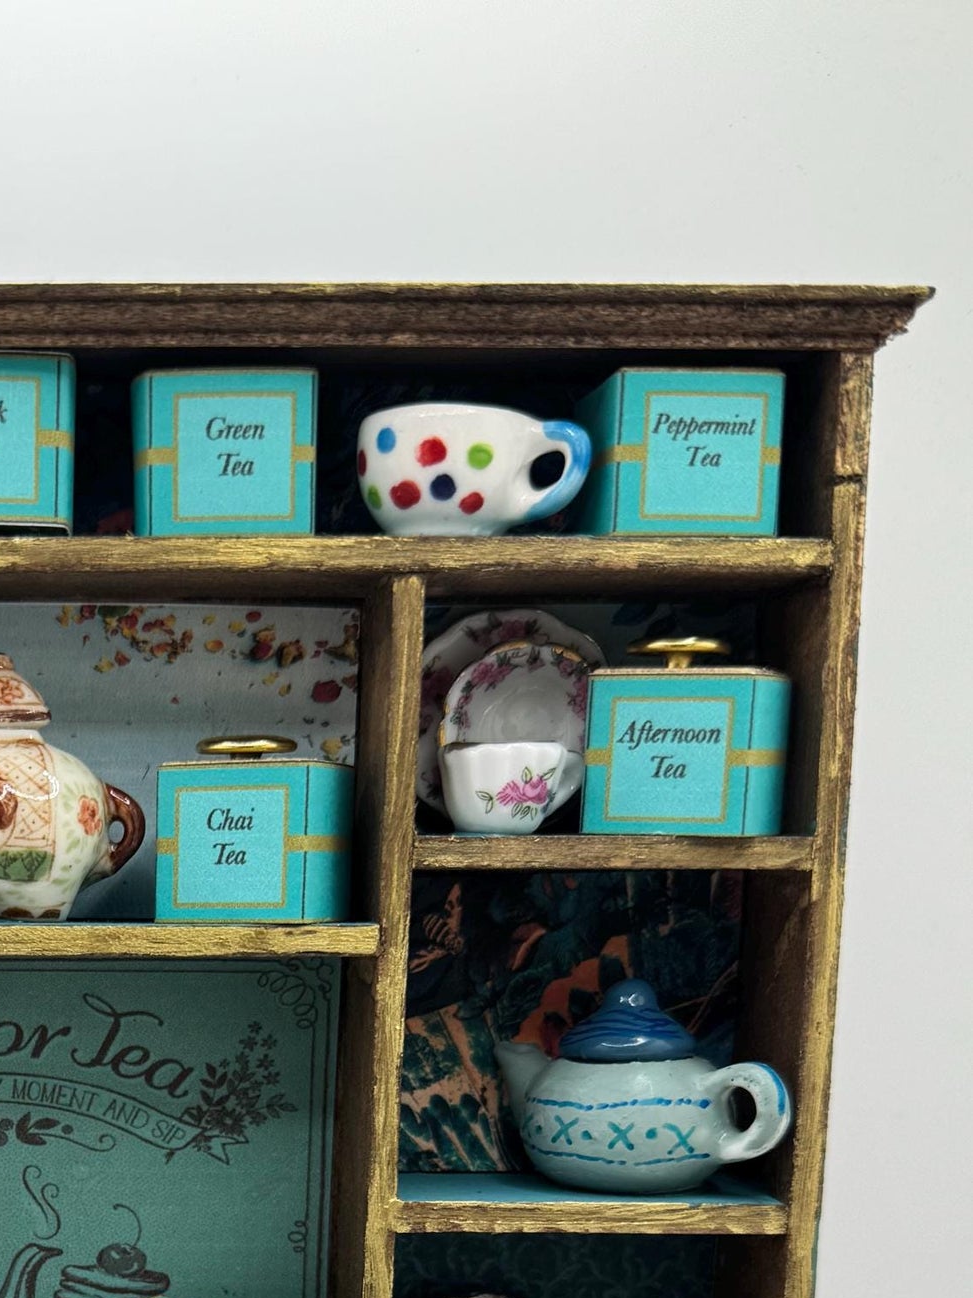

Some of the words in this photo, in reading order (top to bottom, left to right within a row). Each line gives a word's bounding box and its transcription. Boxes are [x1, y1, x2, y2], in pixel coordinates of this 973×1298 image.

[205, 416, 265, 441] Green
[652, 412, 757, 441] Peppermint
[216, 452, 255, 477] Tea
[685, 445, 722, 468] Tea
[616, 719, 722, 751] Afternoon
[650, 755, 687, 780] Tea
[206, 807, 255, 832] Chai
[212, 842, 247, 866] Tea
[70, 992, 195, 1098] Tea
[12, 1079, 100, 1112] MOMENT
[103, 1099, 150, 1130] AND
[151, 1119, 187, 1145] SIP
